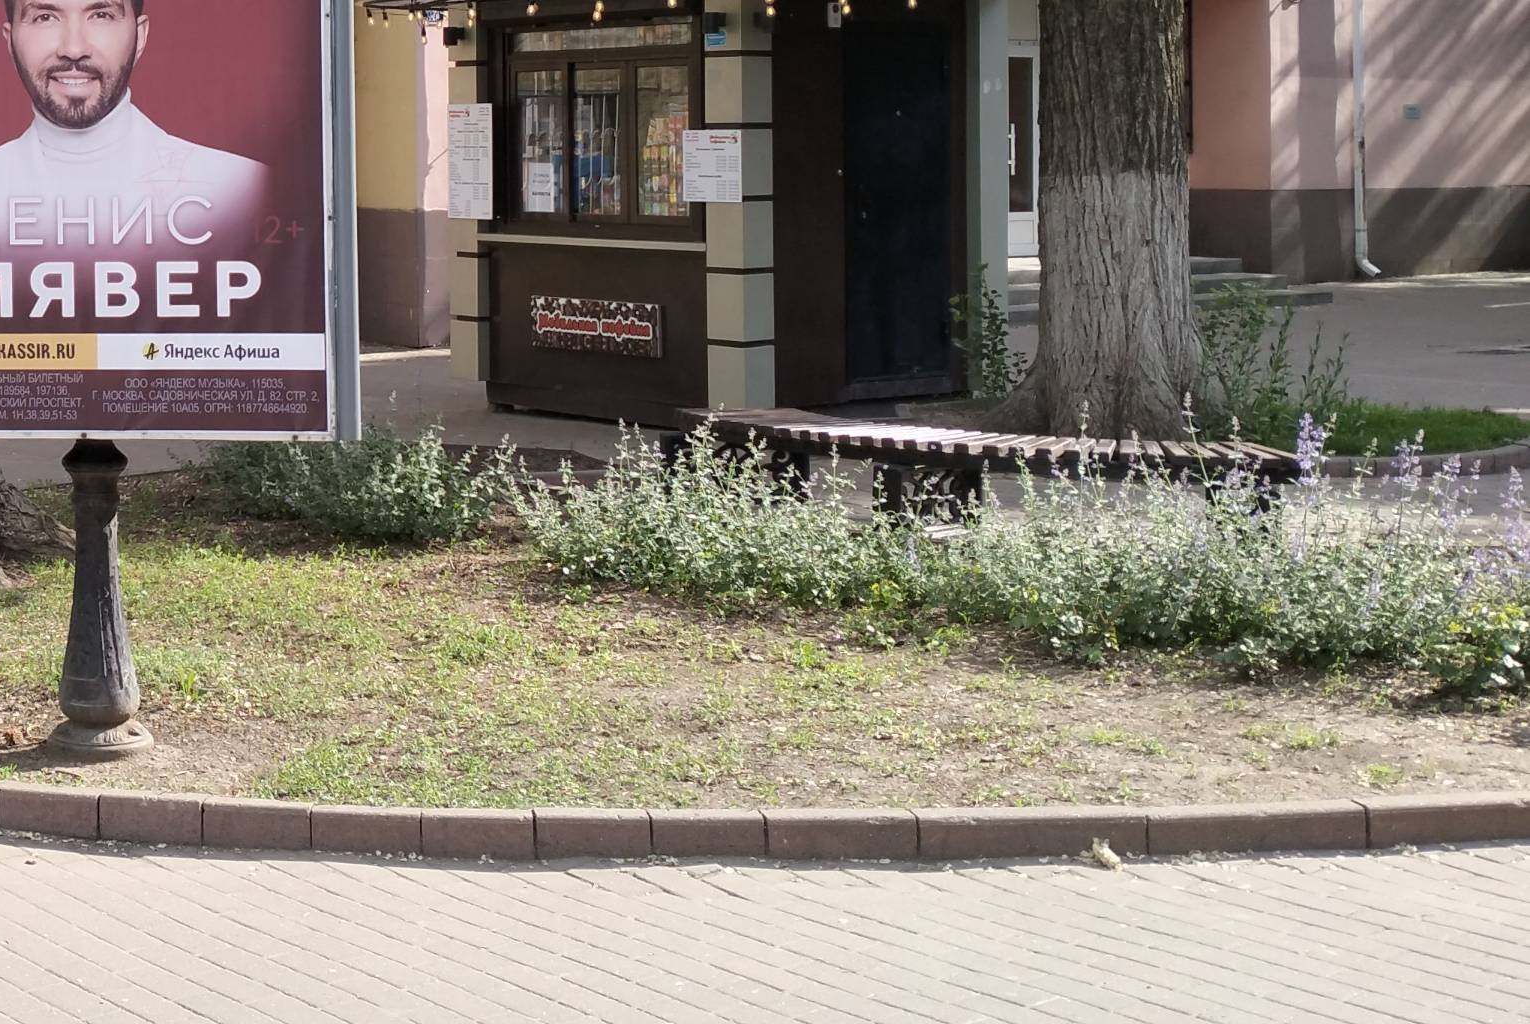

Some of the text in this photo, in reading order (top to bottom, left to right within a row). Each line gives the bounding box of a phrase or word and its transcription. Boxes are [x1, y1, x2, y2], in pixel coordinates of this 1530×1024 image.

[164, 343, 280, 362] Яндекс Афиша
[28, 372, 84, 384] БИЛЕТНЫЙ
[124, 378, 148, 388] ООО
[150, 378, 196, 389] «ЯНДЕКС
[148, 390, 237, 402] САДОВНИЧЕСКАЯ
[102, 403, 169, 414] ПОМЕЩЕНИЕ
